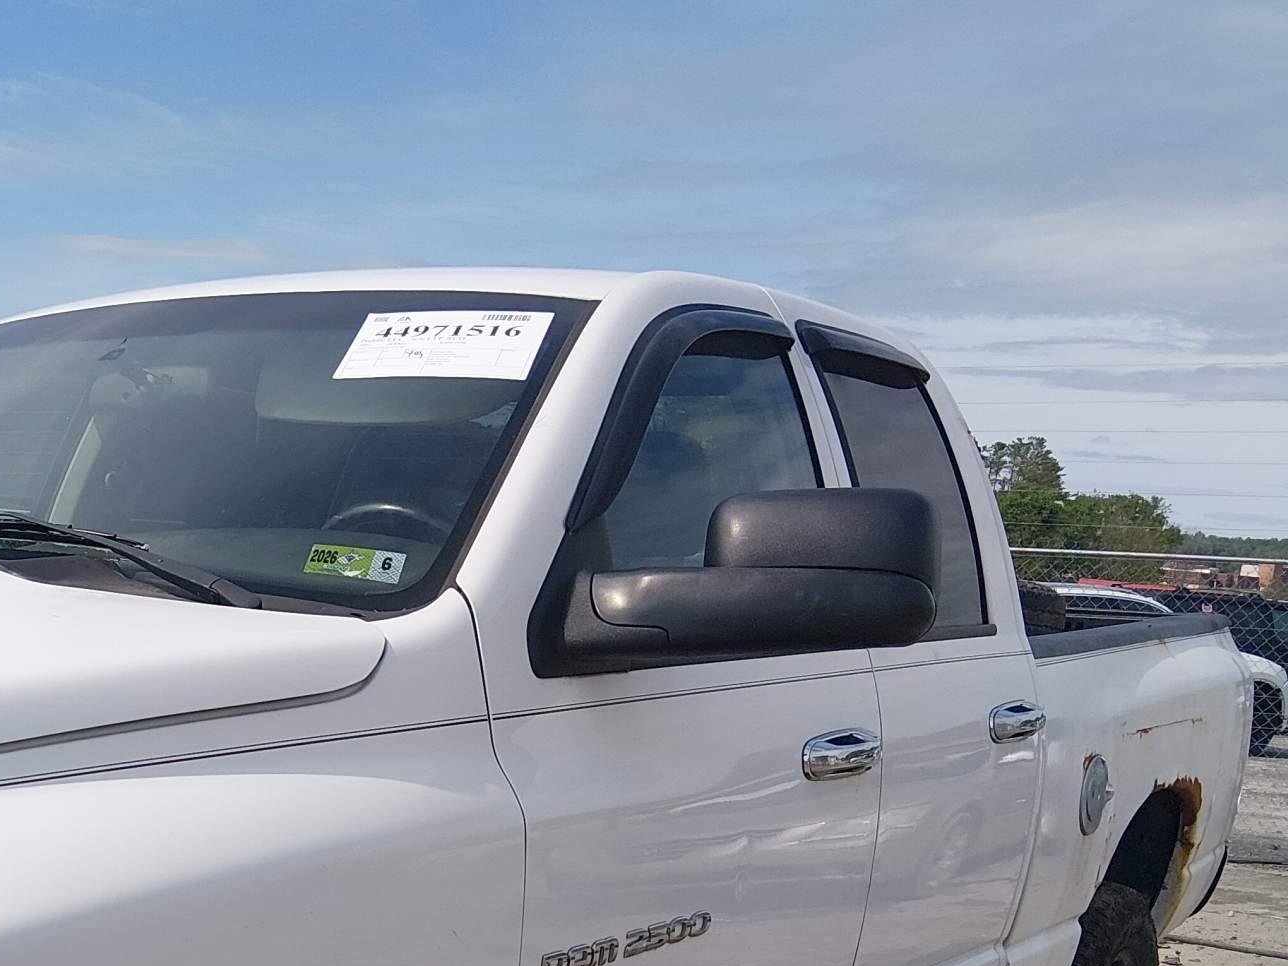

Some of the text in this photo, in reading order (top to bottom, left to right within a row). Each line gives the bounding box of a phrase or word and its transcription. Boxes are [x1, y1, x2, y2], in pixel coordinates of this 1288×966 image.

[375, 324, 522, 338] 44971516
[310, 549, 339, 564] 2026
[382, 557, 393, 571] 6
[623, 909, 712, 958] 2500
